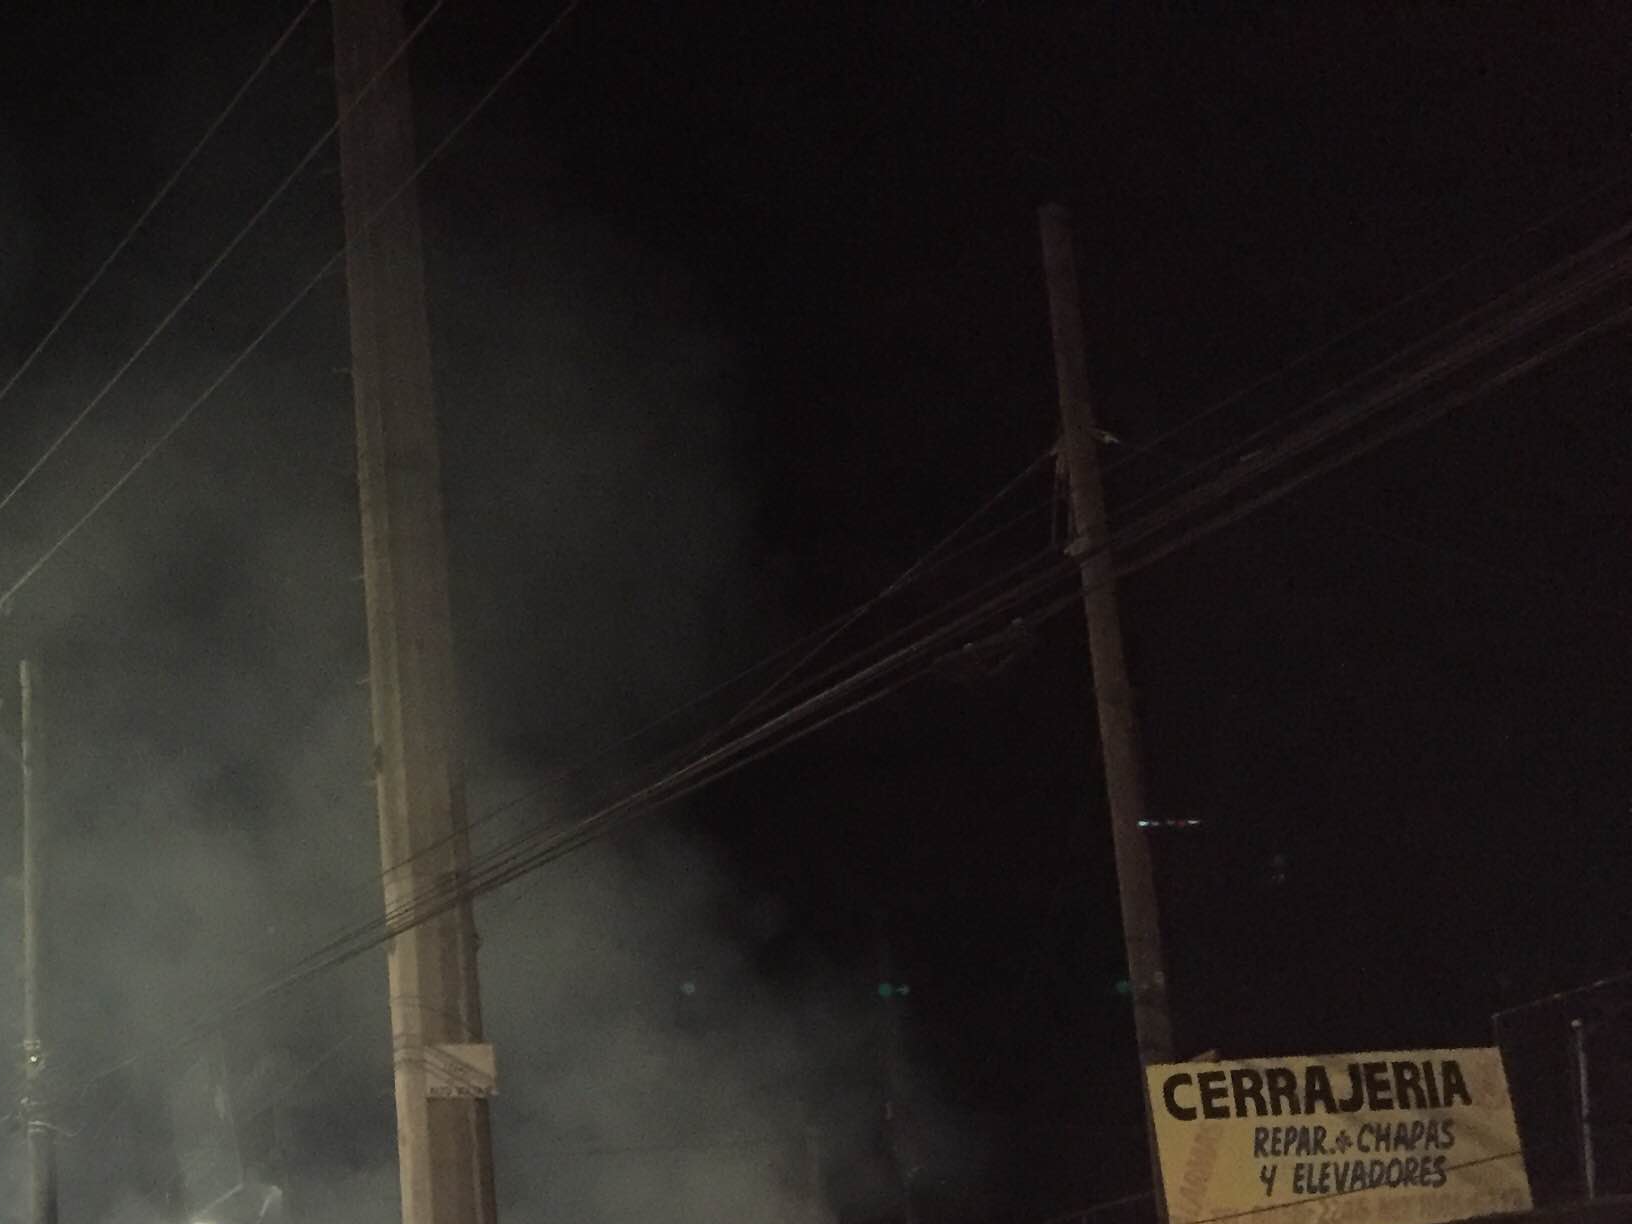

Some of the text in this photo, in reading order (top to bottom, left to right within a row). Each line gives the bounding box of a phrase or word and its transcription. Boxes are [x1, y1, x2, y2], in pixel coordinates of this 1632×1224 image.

[1162, 1058, 1472, 1121] CERRAJERIA
[1357, 1118, 1455, 1153] CHAPAS
[1292, 1155, 1448, 1195] ELEVADORES
